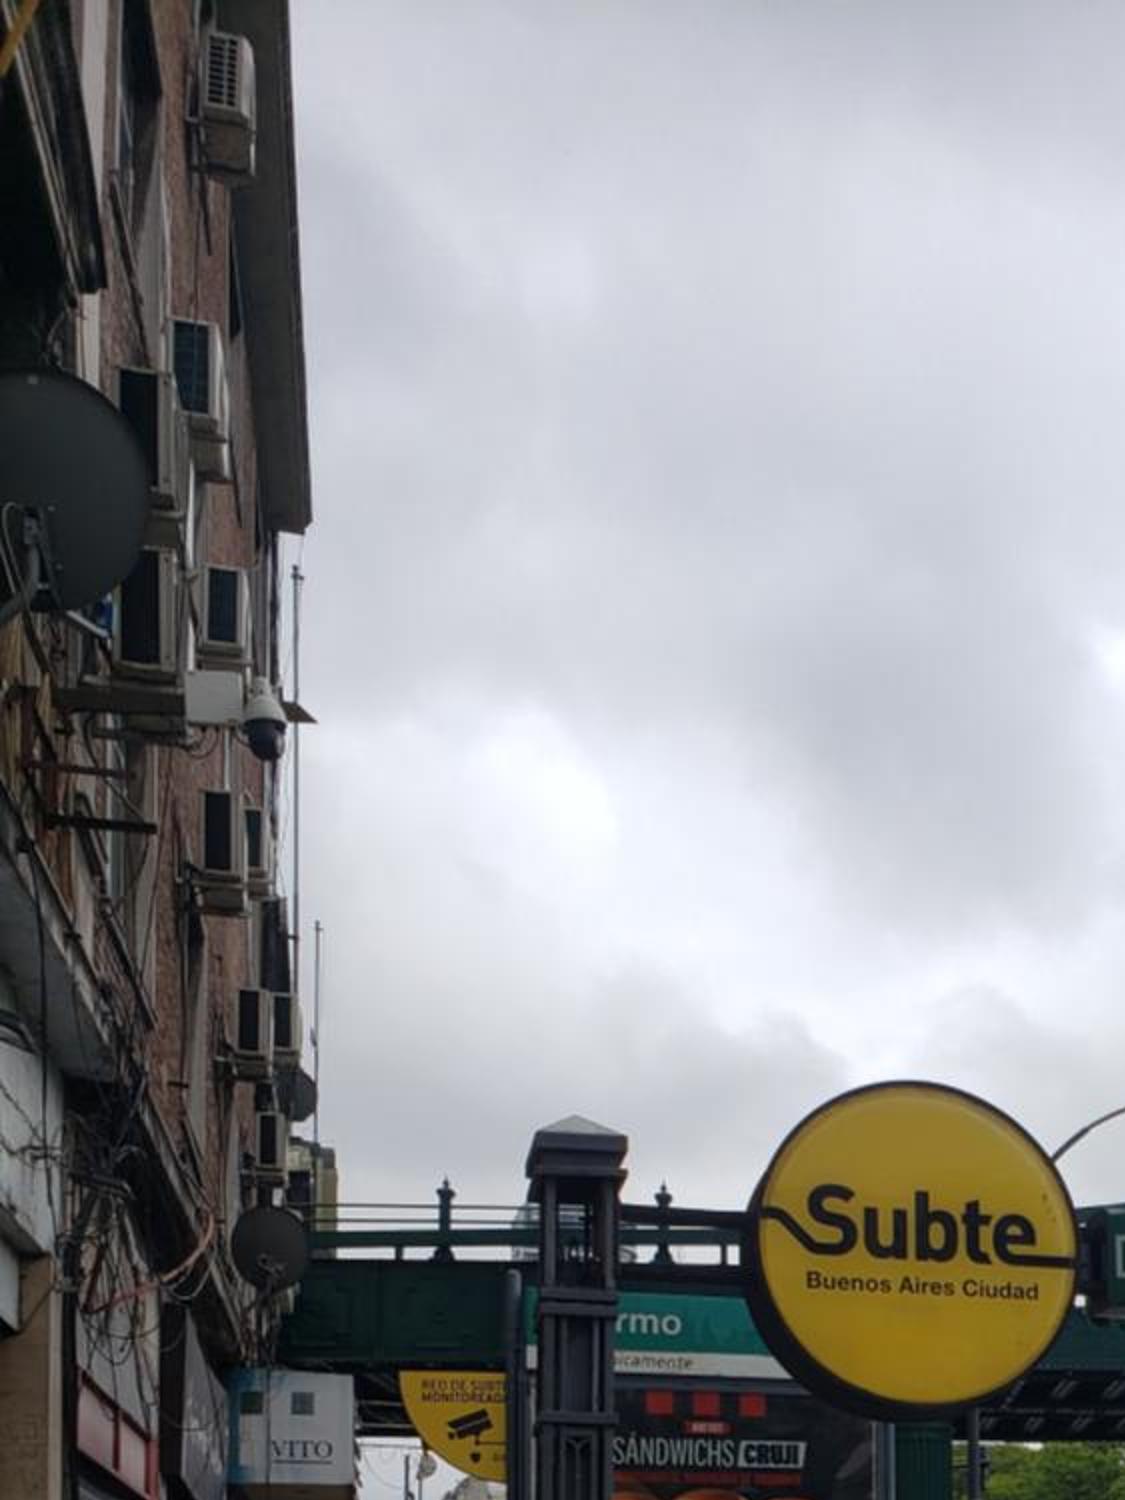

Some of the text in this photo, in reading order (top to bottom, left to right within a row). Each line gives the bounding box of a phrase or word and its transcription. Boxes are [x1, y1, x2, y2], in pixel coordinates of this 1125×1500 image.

[805, 1183, 1040, 1269] Subte
[806, 1270, 1040, 1302] Buenos Aires Ciudad
[614, 1311, 683, 1336] rmo
[271, 1439, 334, 1458] VITO
[611, 1431, 801, 1467] SÁNDWICHS CRUJI
